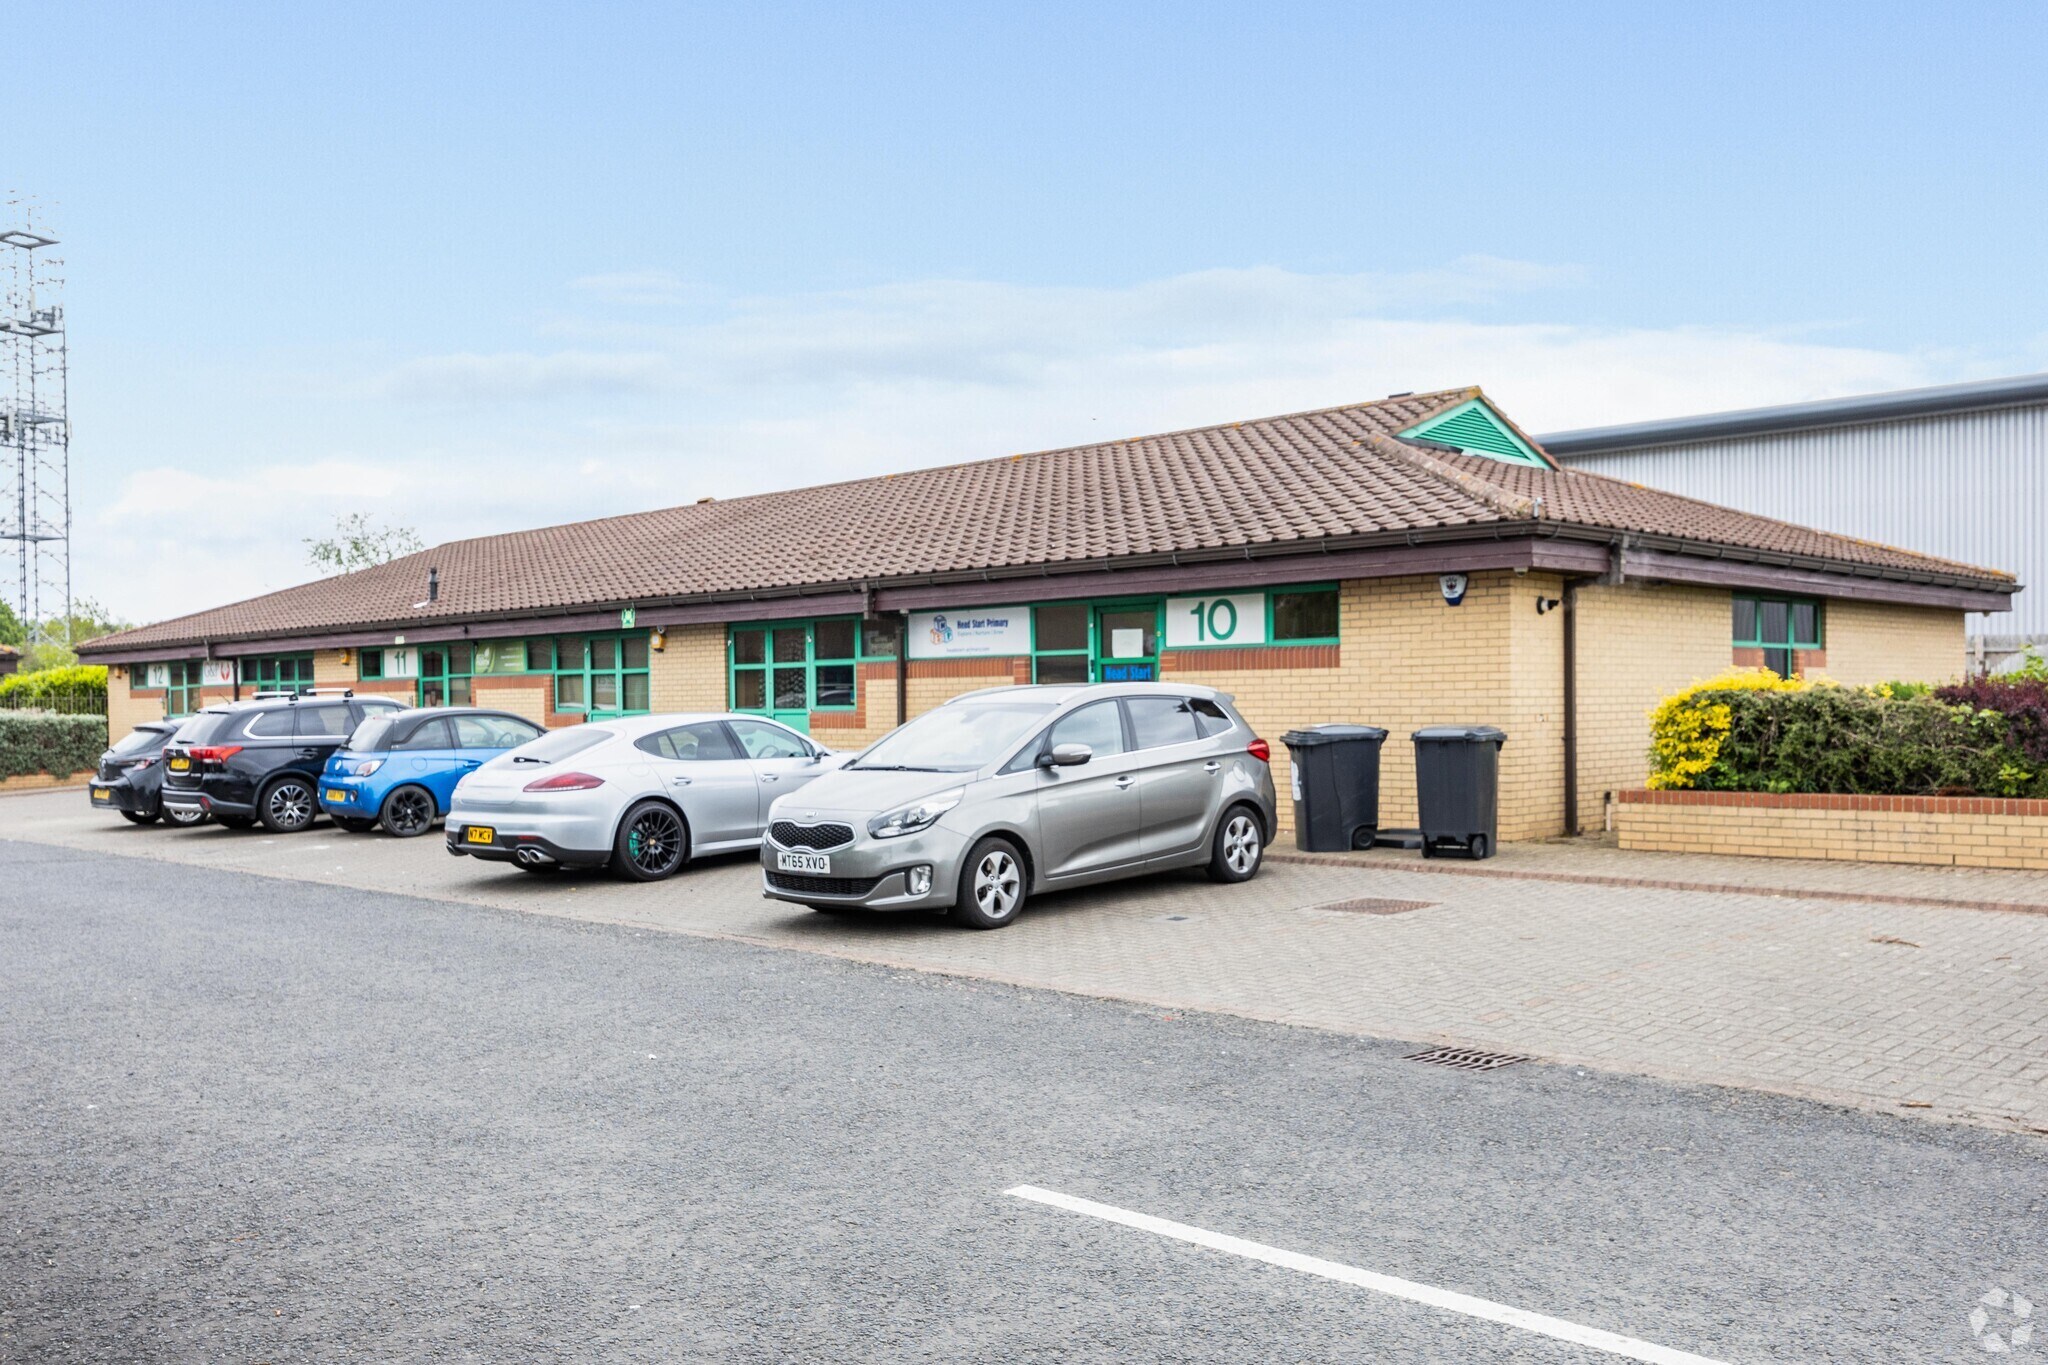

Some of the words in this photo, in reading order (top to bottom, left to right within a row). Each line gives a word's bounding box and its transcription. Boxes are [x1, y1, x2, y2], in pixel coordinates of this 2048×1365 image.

[957, 620, 970, 629] Head
[972, 619, 985, 628] Start
[986, 618, 1008, 628] Primary
[1190, 598, 1237, 641] 10
[394, 651, 407, 674] 11
[153, 665, 163, 684] 12
[1105, 666, 1127, 680] Head
[1131, 665, 1150, 680] Start
[781, 854, 803, 868] MT65
[805, 856, 825, 870] XVO
